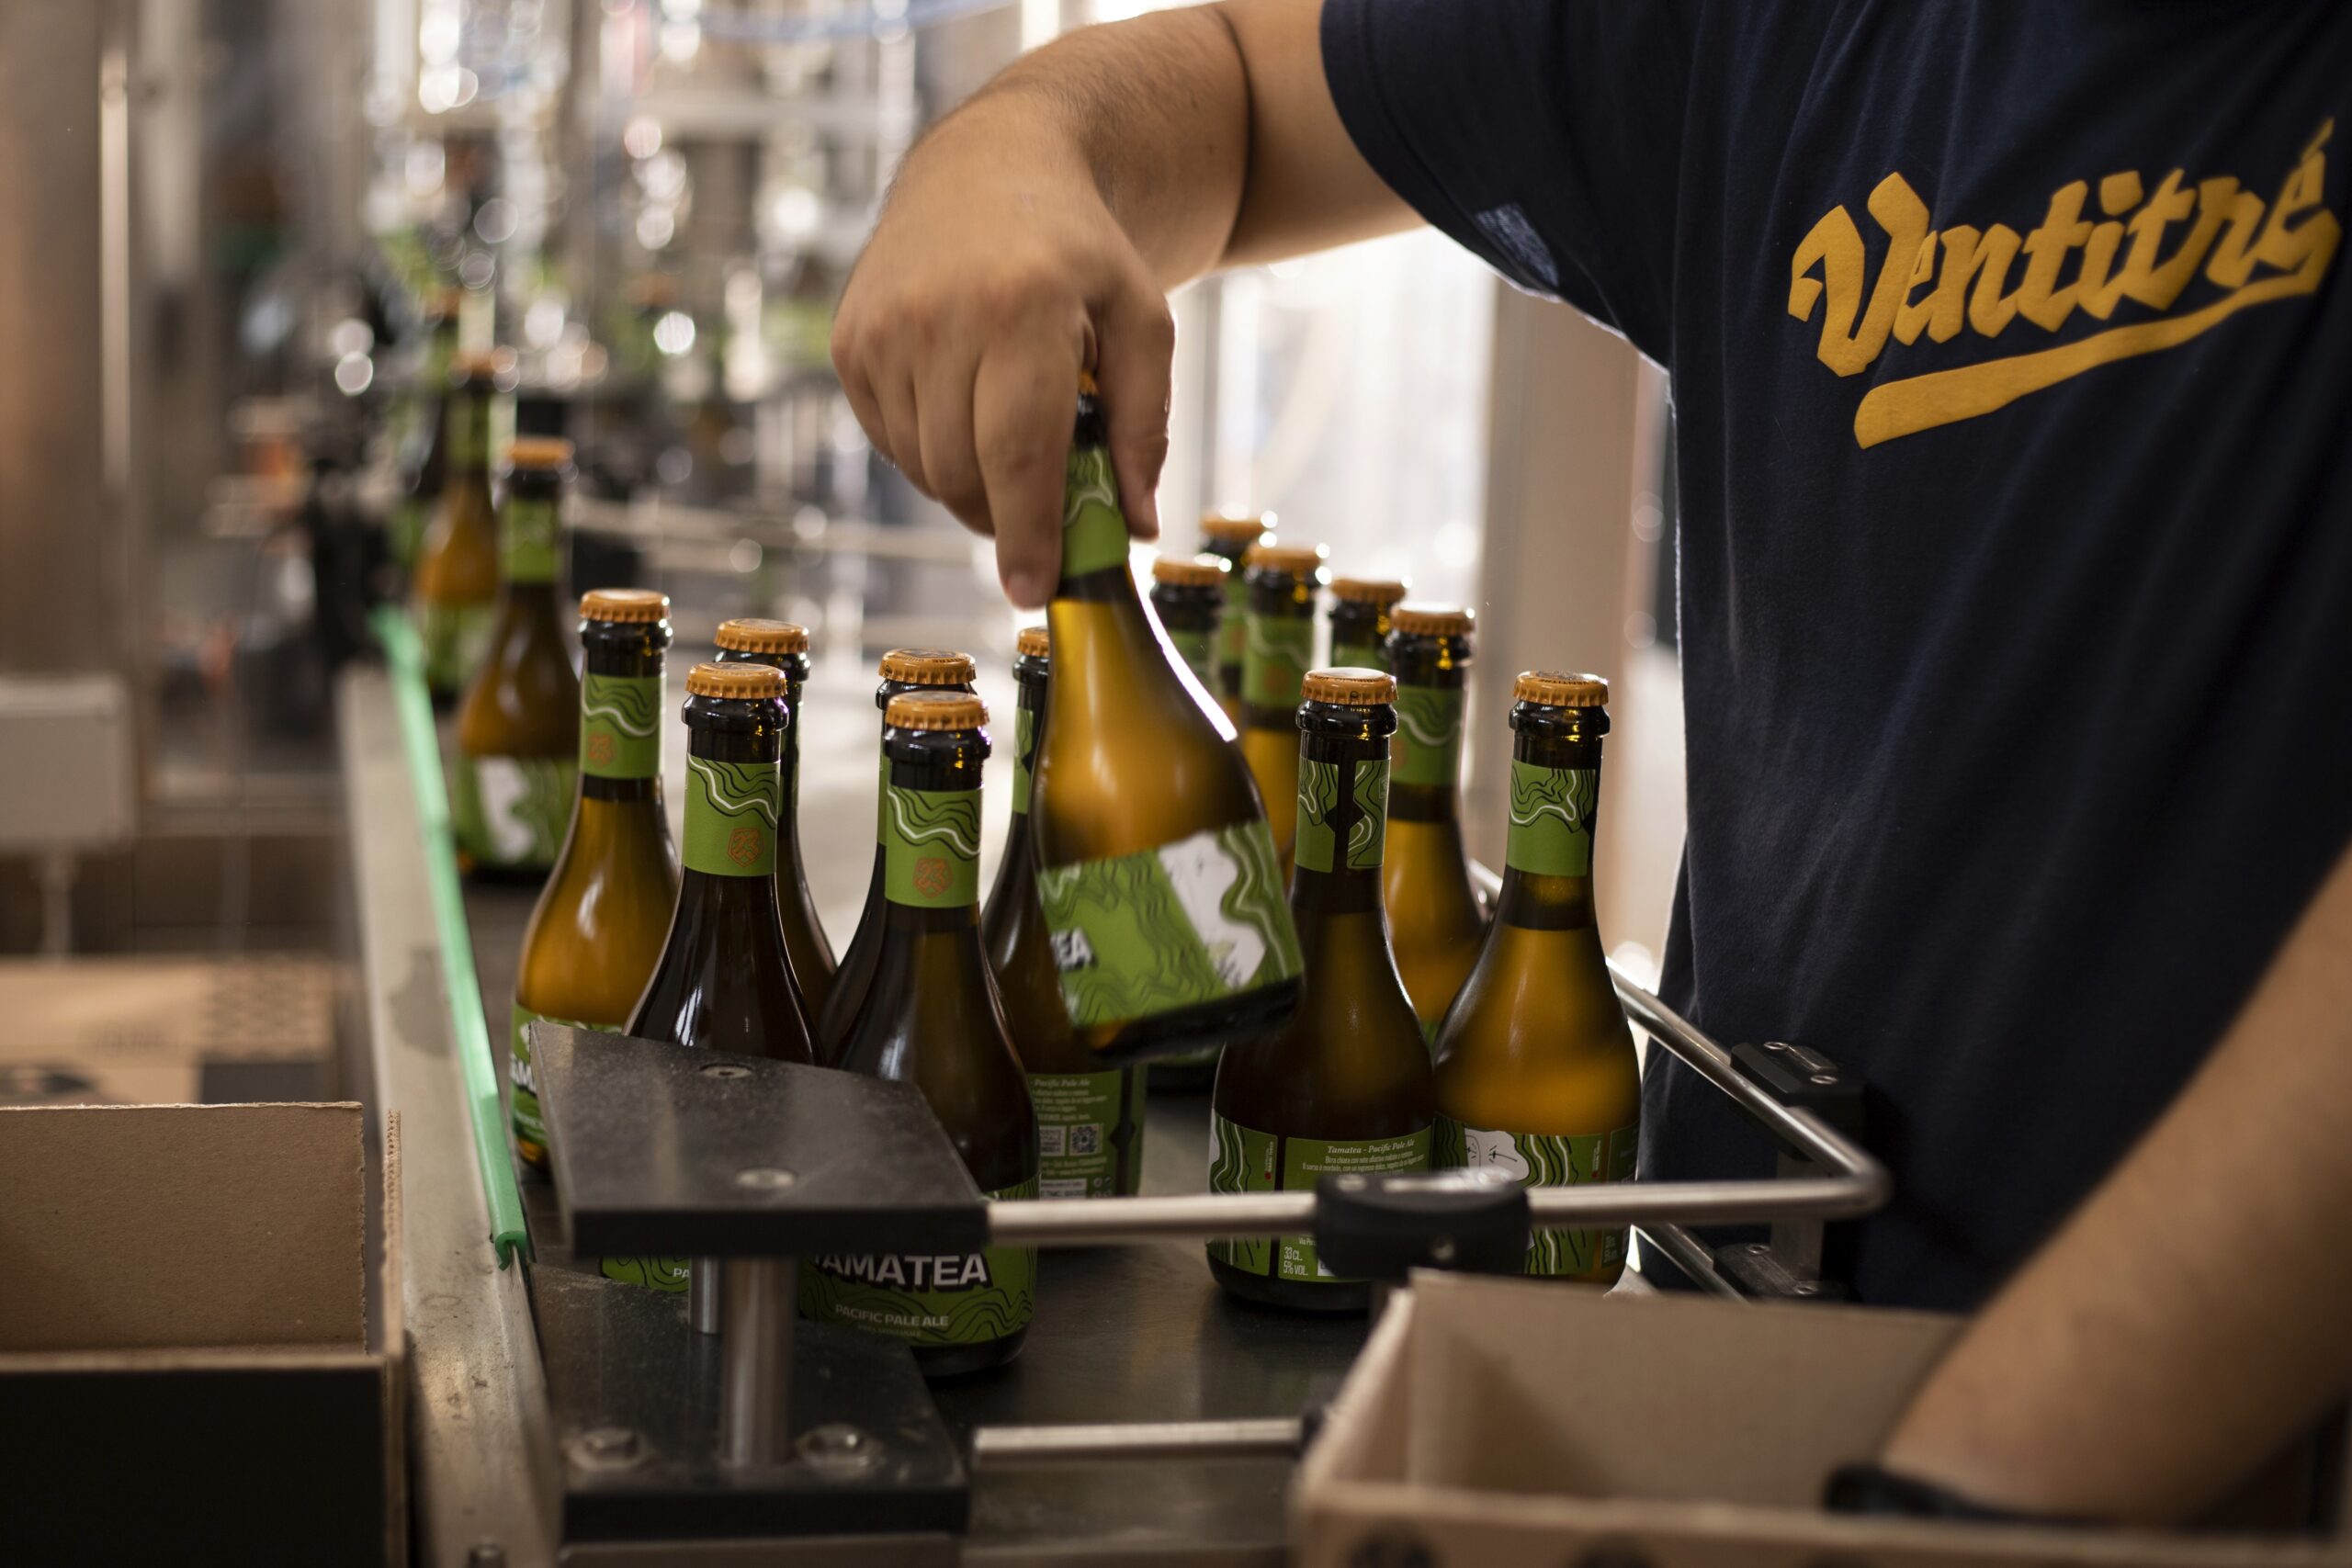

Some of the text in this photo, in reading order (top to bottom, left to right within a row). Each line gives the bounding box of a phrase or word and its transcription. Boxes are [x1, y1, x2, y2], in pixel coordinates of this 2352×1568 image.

[1328, 1145, 1362, 1154] Tamatea
[1368, 1144, 1391, 1155] Pacific
[1392, 1141, 1406, 1151] Pale
[1283, 1247, 1293, 1260] 33
[816, 1251, 988, 1286] AMATEA
[1295, 1264, 1308, 1276] VOL.
[836, 1303, 949, 1327] PACIFIC PALE ALE
